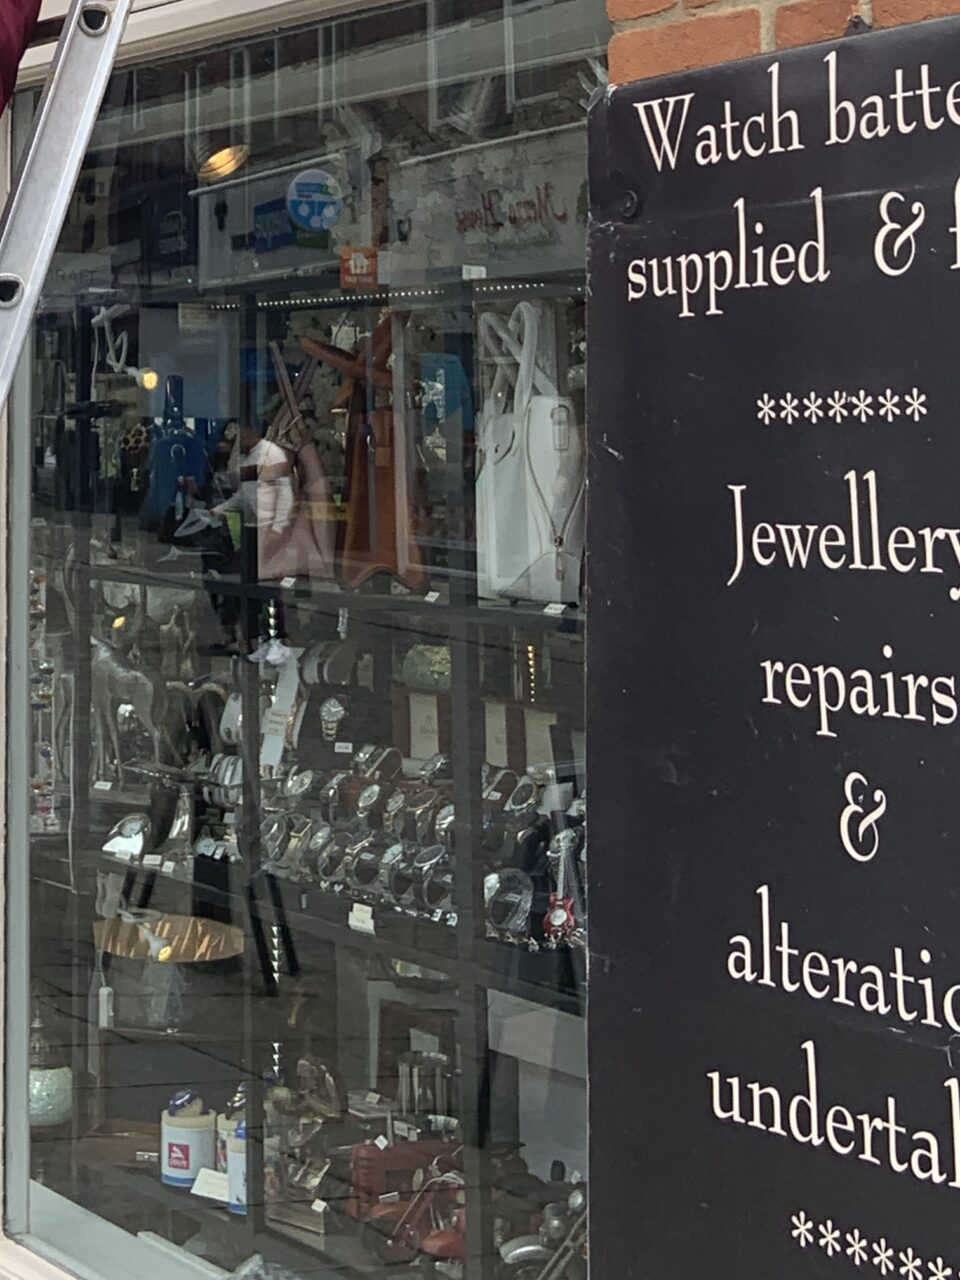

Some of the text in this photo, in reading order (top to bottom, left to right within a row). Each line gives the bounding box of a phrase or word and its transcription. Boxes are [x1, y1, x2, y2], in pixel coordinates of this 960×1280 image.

[633, 62, 805, 172] Watch
[627, 187, 830, 318] supplied
[874, 191, 925, 276] &
[759, 644, 959, 738] repairs
[840, 771, 887, 862] &
